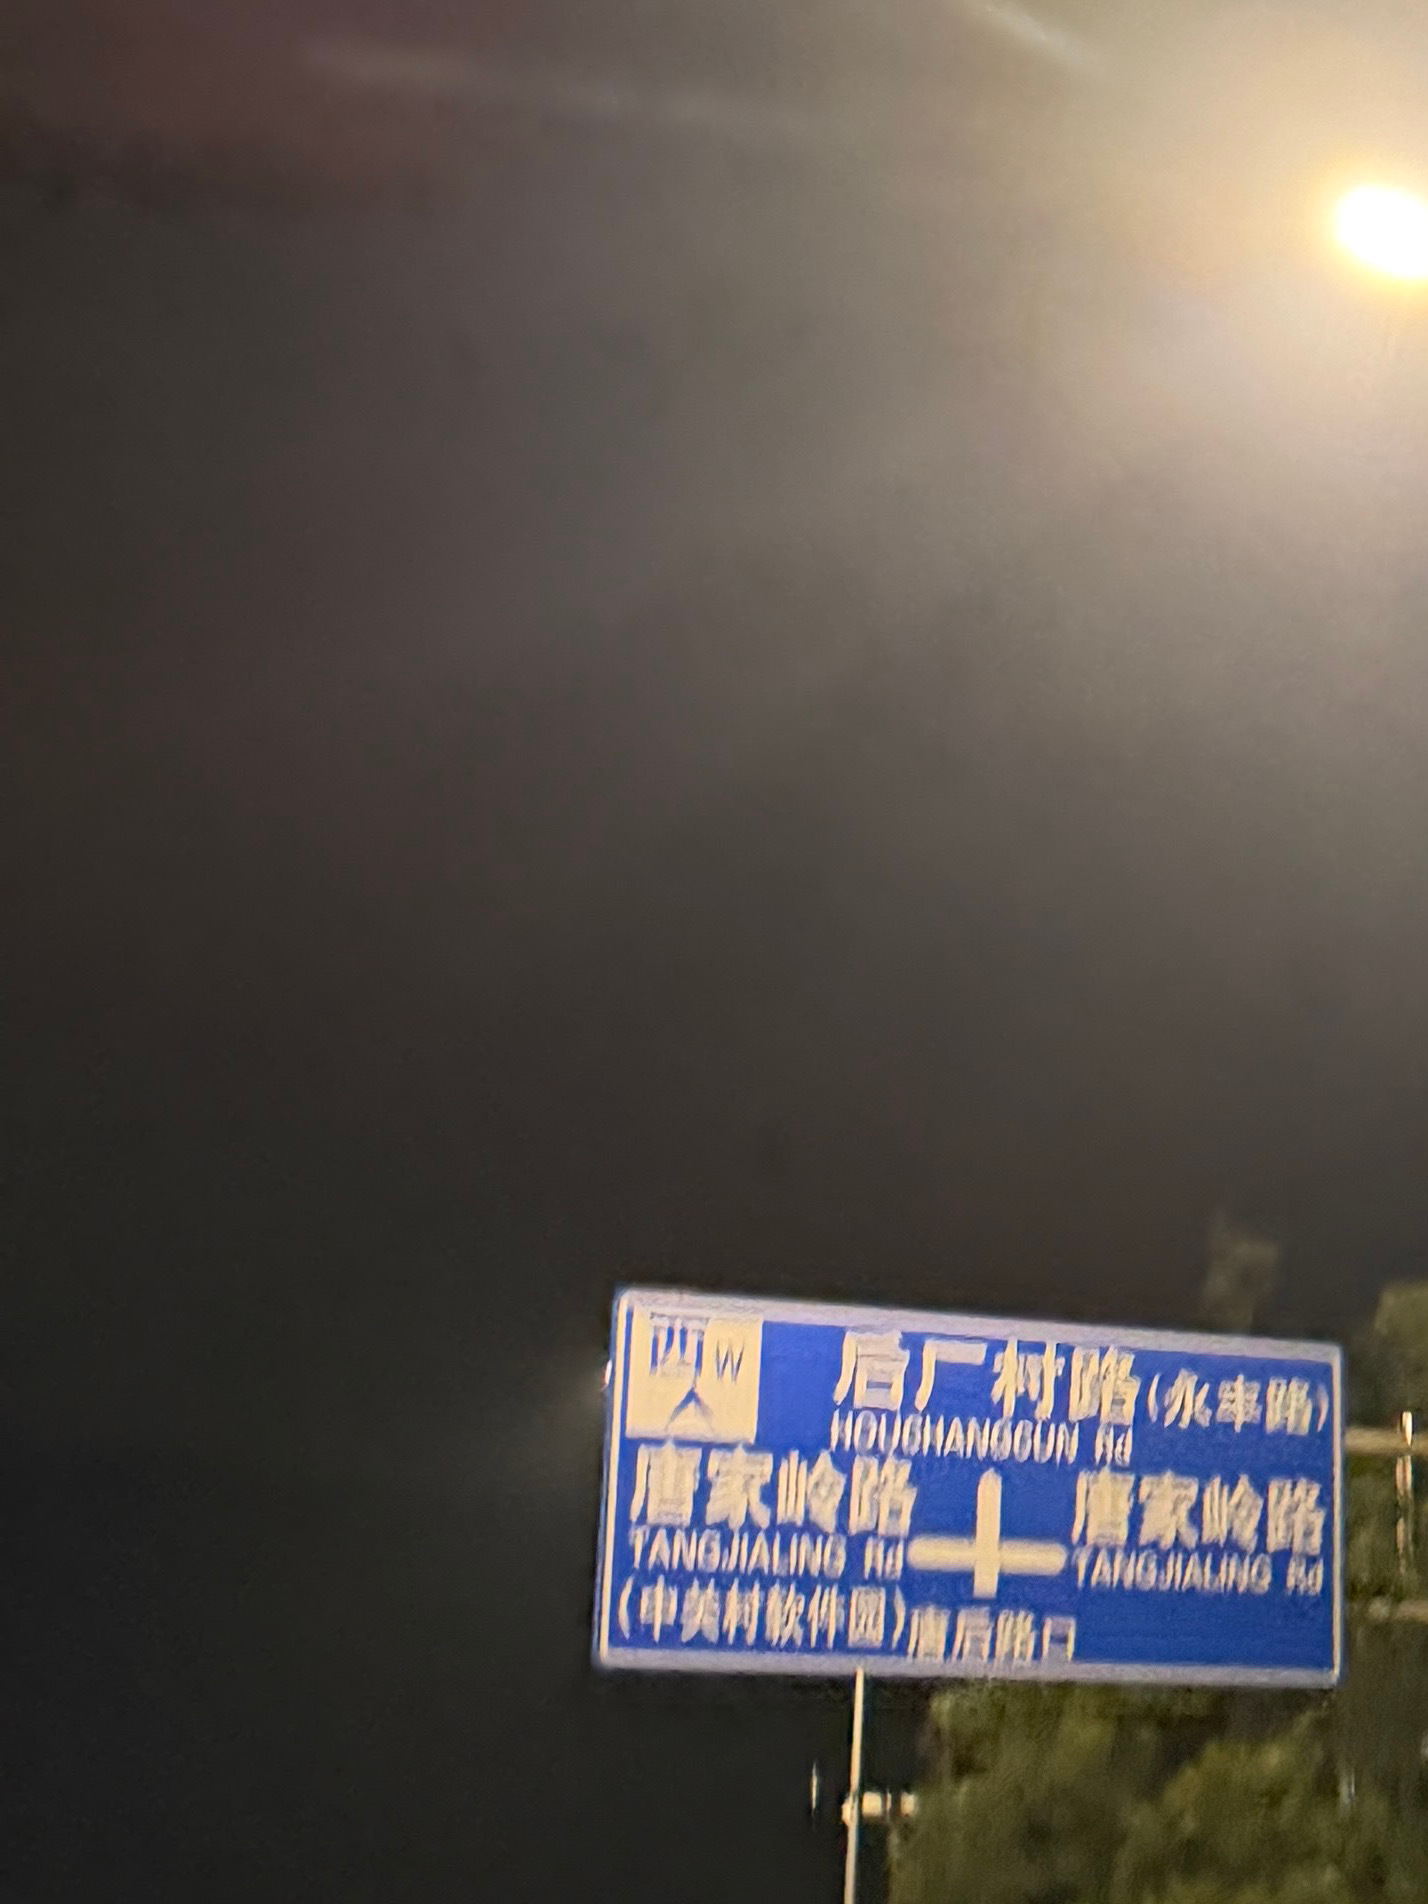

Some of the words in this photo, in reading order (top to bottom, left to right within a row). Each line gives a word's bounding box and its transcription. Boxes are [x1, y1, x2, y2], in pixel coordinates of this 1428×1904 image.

[714, 1338, 747, 1385] W
[834, 1329, 1141, 1426] 后厂村路
[629, 1440, 918, 1537] 唐家岭路
[1072, 1465, 1326, 1556] 唐家岭路
[629, 1525, 847, 1579] TANGJIALING
[864, 1535, 905, 1581] Rd
[1073, 1543, 1273, 1595] TANGJIALING
